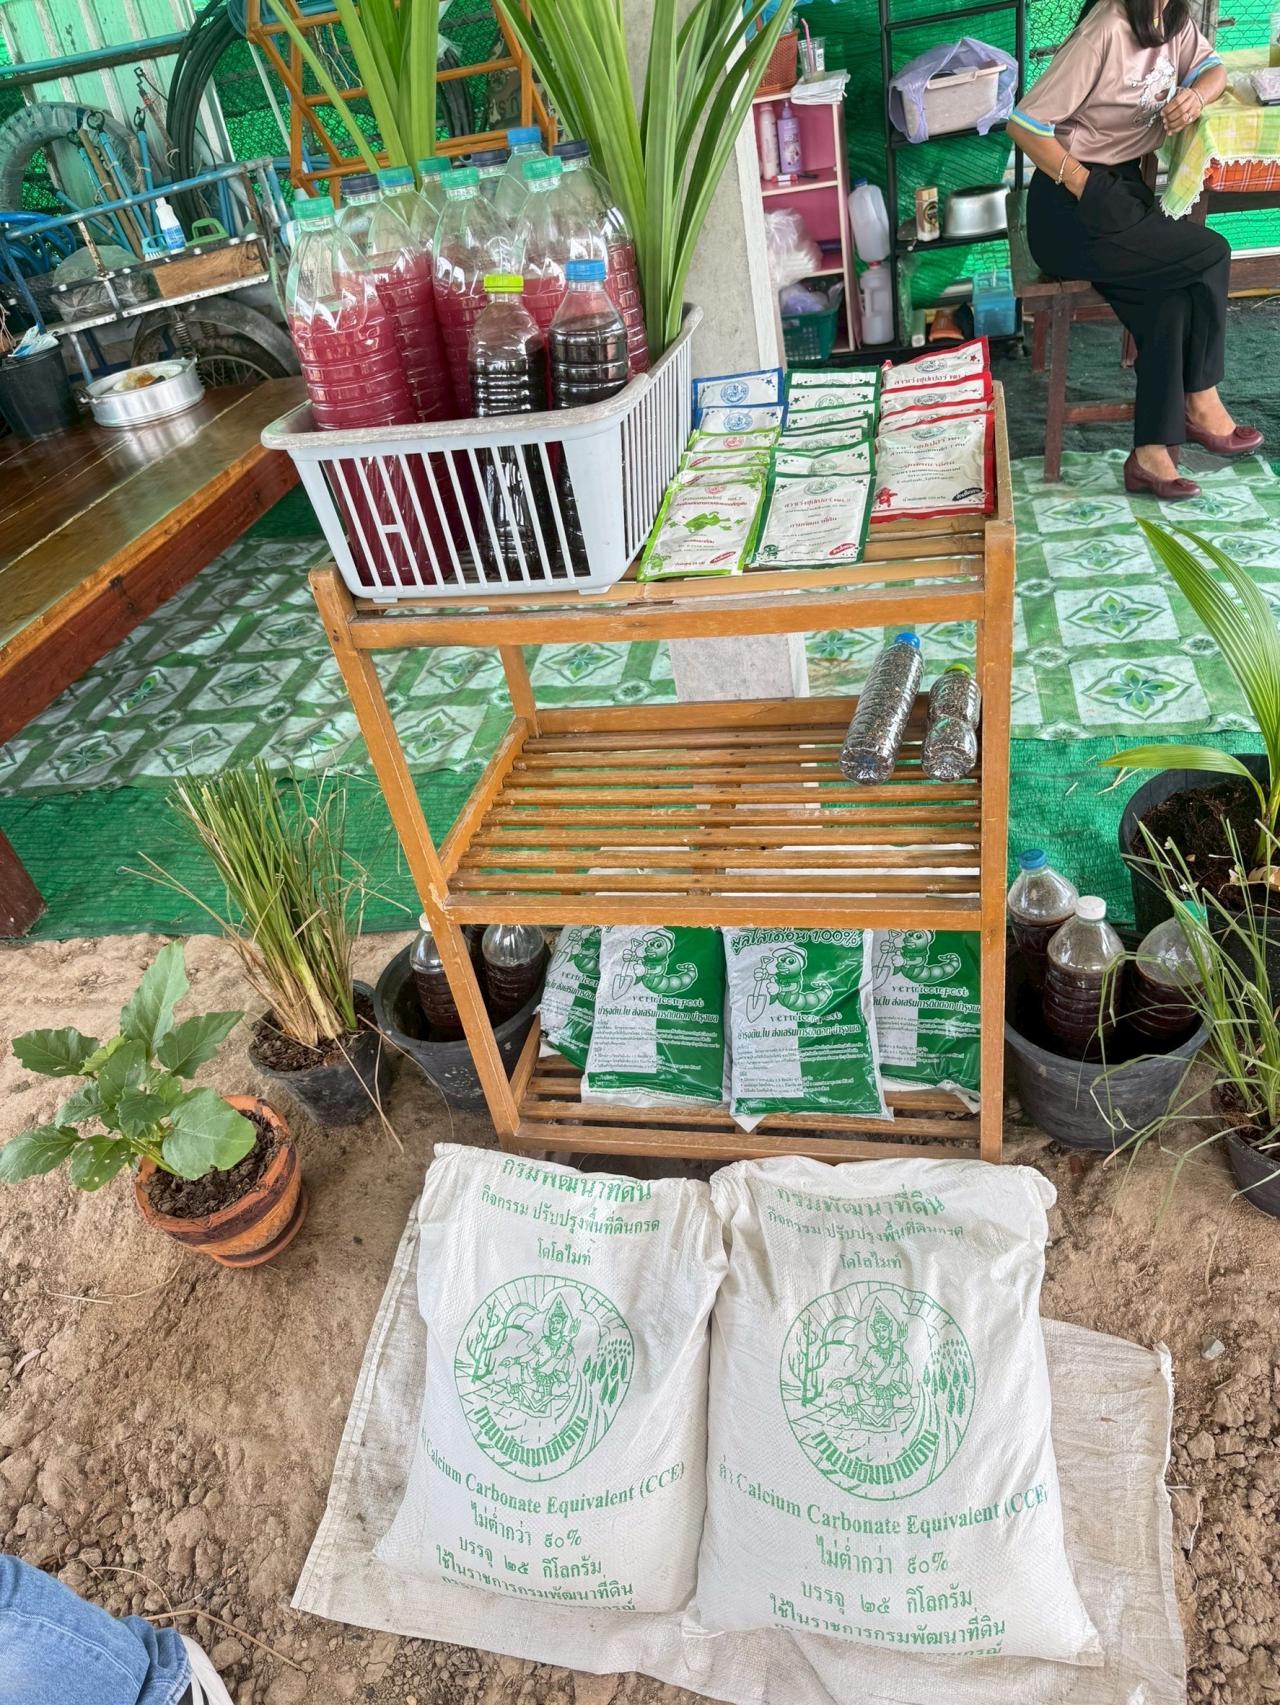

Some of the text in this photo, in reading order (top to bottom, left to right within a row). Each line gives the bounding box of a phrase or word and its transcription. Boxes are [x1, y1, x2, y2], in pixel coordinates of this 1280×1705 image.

[812, 928, 859, 948] 100%
[481, 1184, 660, 1235] กิจกรรม ปรับปรุงพื้นที่ดินกรด
[767, 1205, 822, 1235] กิจกรรม
[537, 1238, 592, 1266] โดโลไมท์
[839, 1250, 902, 1270] โดโลไมท์
[427, 1439, 462, 1484] Calcium
[465, 1473, 541, 1514] Carbonate
[547, 1486, 635, 1518] Equivalent
[640, 1461, 685, 1498] (CCE)
[470, 1500, 531, 1546] ไม่ต่ำกว่า
[736, 1472, 801, 1518] Calcium
[807, 1503, 901, 1536] Carbonate
[906, 1502, 1000, 1539] Equivalent
[436, 1545, 633, 1600] ใช้ในราชการกรมพัฒนาที่ดิน
[459, 1536, 602, 1579] บรรจุ ๒๕ กิโลกรัม
[816, 1534, 893, 1574] ไม่ต่ำกว่า
[769, 1592, 1006, 1645] ใช้ในราชการกรมพัฒนาที่ดิน
[801, 1581, 972, 1615] บรรจุ ๒๕ กิโลกรัม
